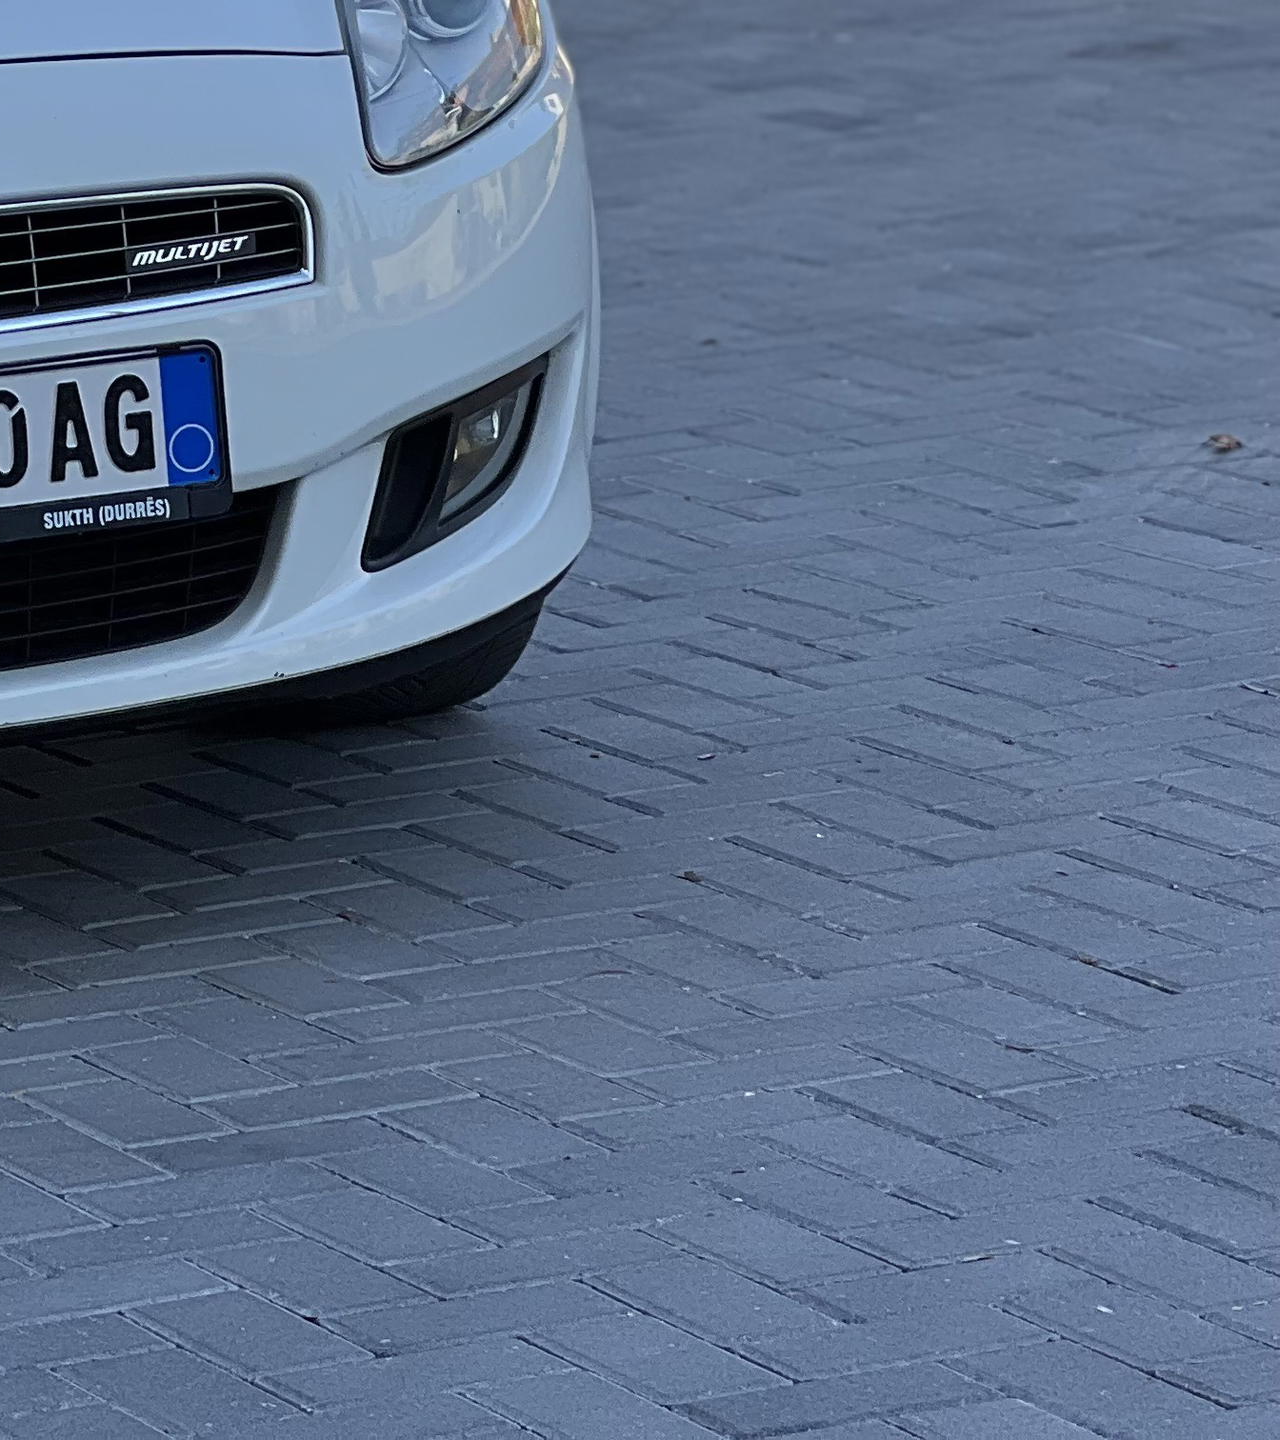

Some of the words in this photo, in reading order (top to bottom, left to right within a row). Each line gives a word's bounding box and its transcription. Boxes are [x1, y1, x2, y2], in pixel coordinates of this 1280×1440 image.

[131, 235, 249, 268] MULTIJET
[48, 373, 157, 482] AG
[43, 507, 94, 530] SUKTH
